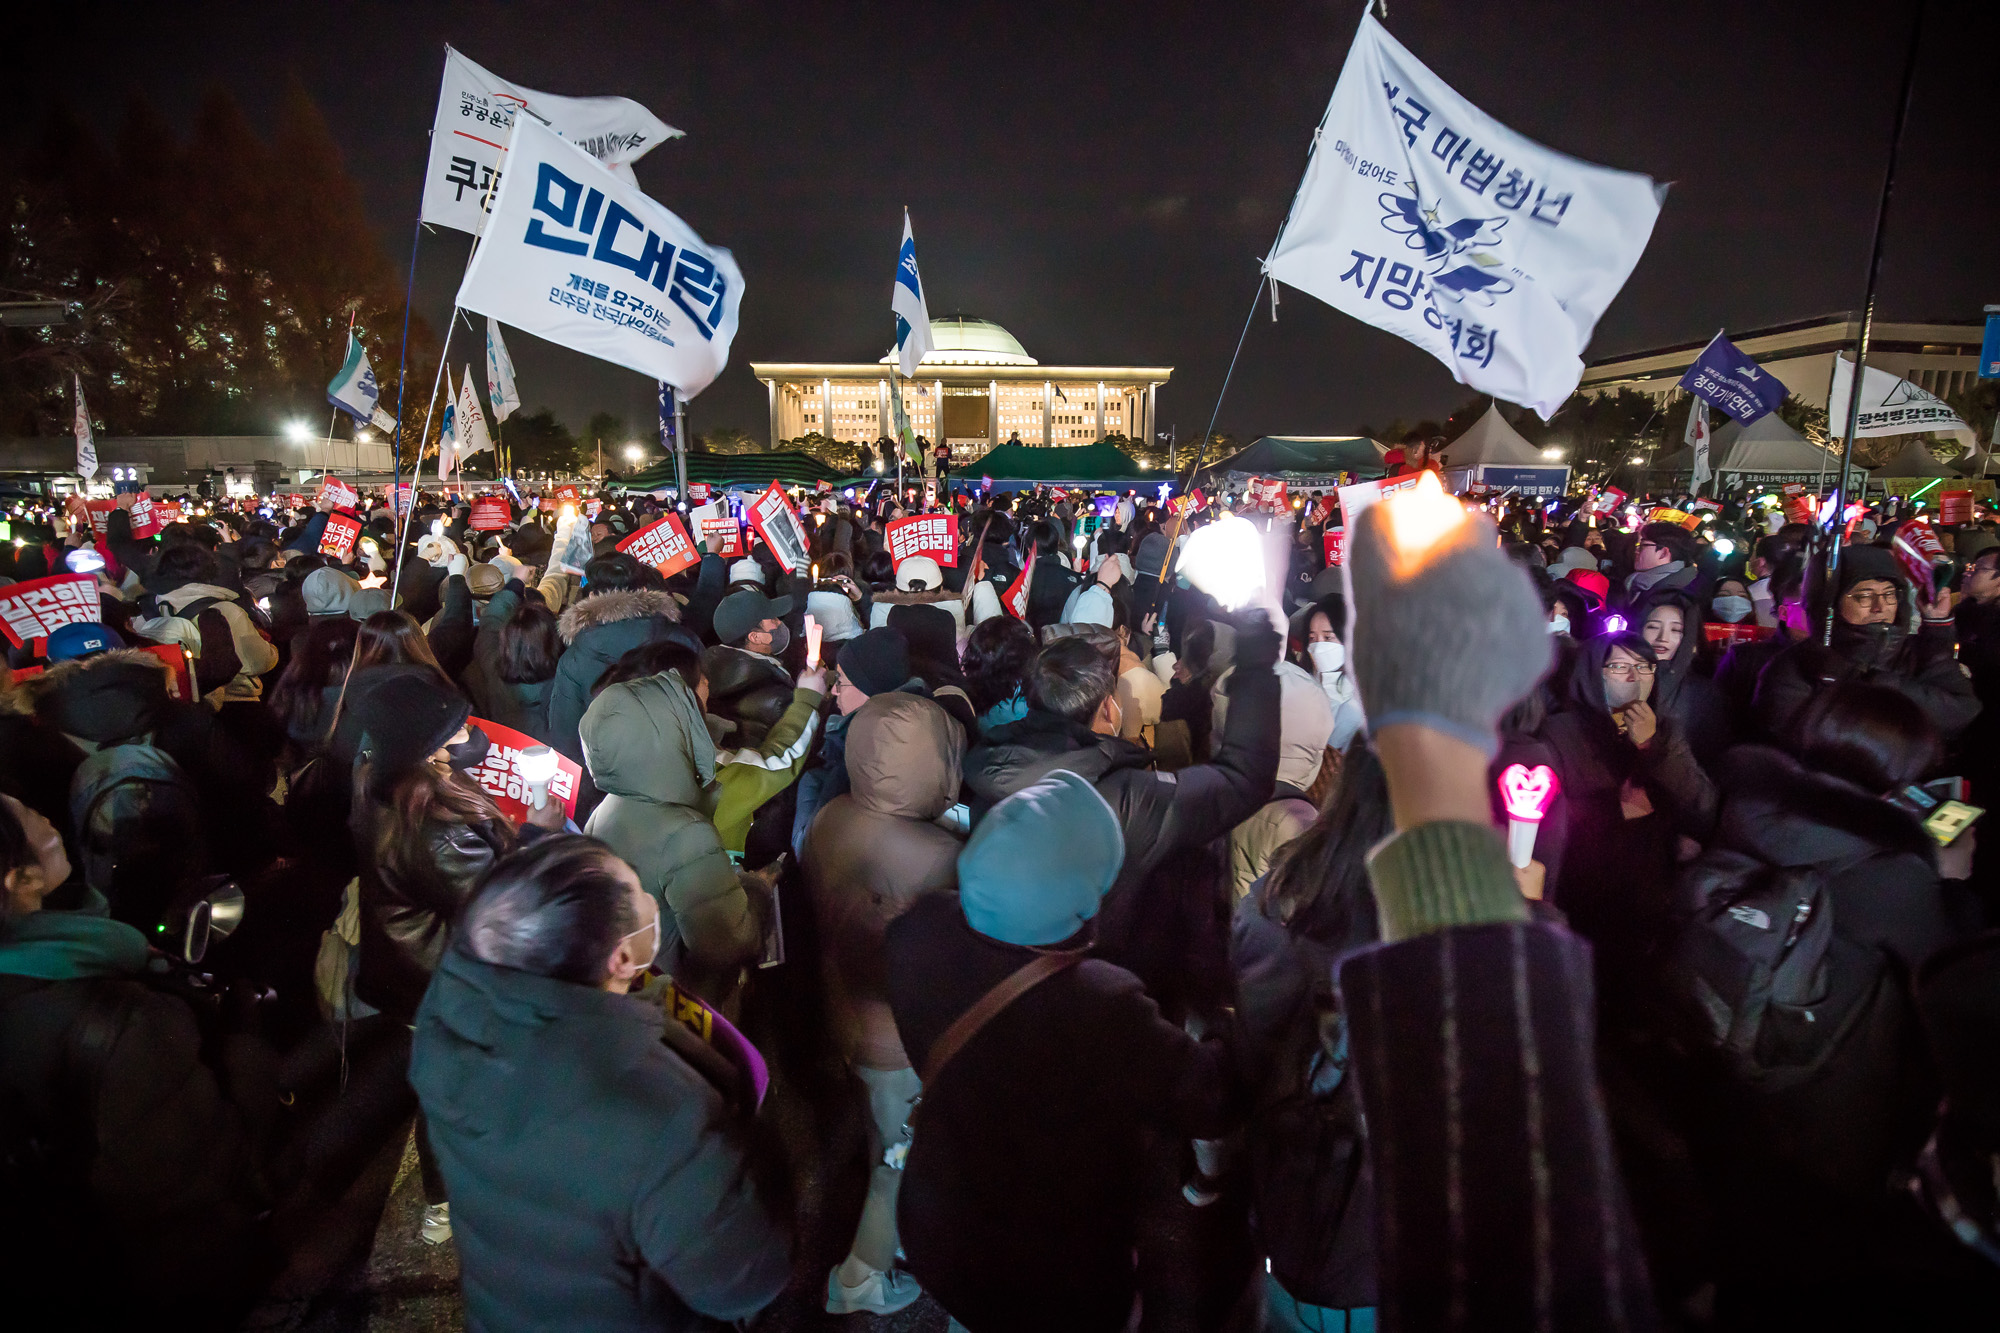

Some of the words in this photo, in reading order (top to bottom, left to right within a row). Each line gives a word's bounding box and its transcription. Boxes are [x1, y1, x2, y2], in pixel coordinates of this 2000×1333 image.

[1358, 160, 1398, 186] 없어도
[523, 162, 726, 342] 민대련
[549, 286, 591, 315] 민주당
[566, 272, 610, 301] 개혁을
[610, 290, 671, 331] 요구하는
[556, 488, 575, 502] 탄핵
[322, 532, 351, 549] 지키자
[327, 521, 356, 539] 힘으로
[891, 518, 948, 546] 김건희를
[893, 534, 953, 562] 특검하라!
[0, 580, 99, 622] 김건희를
